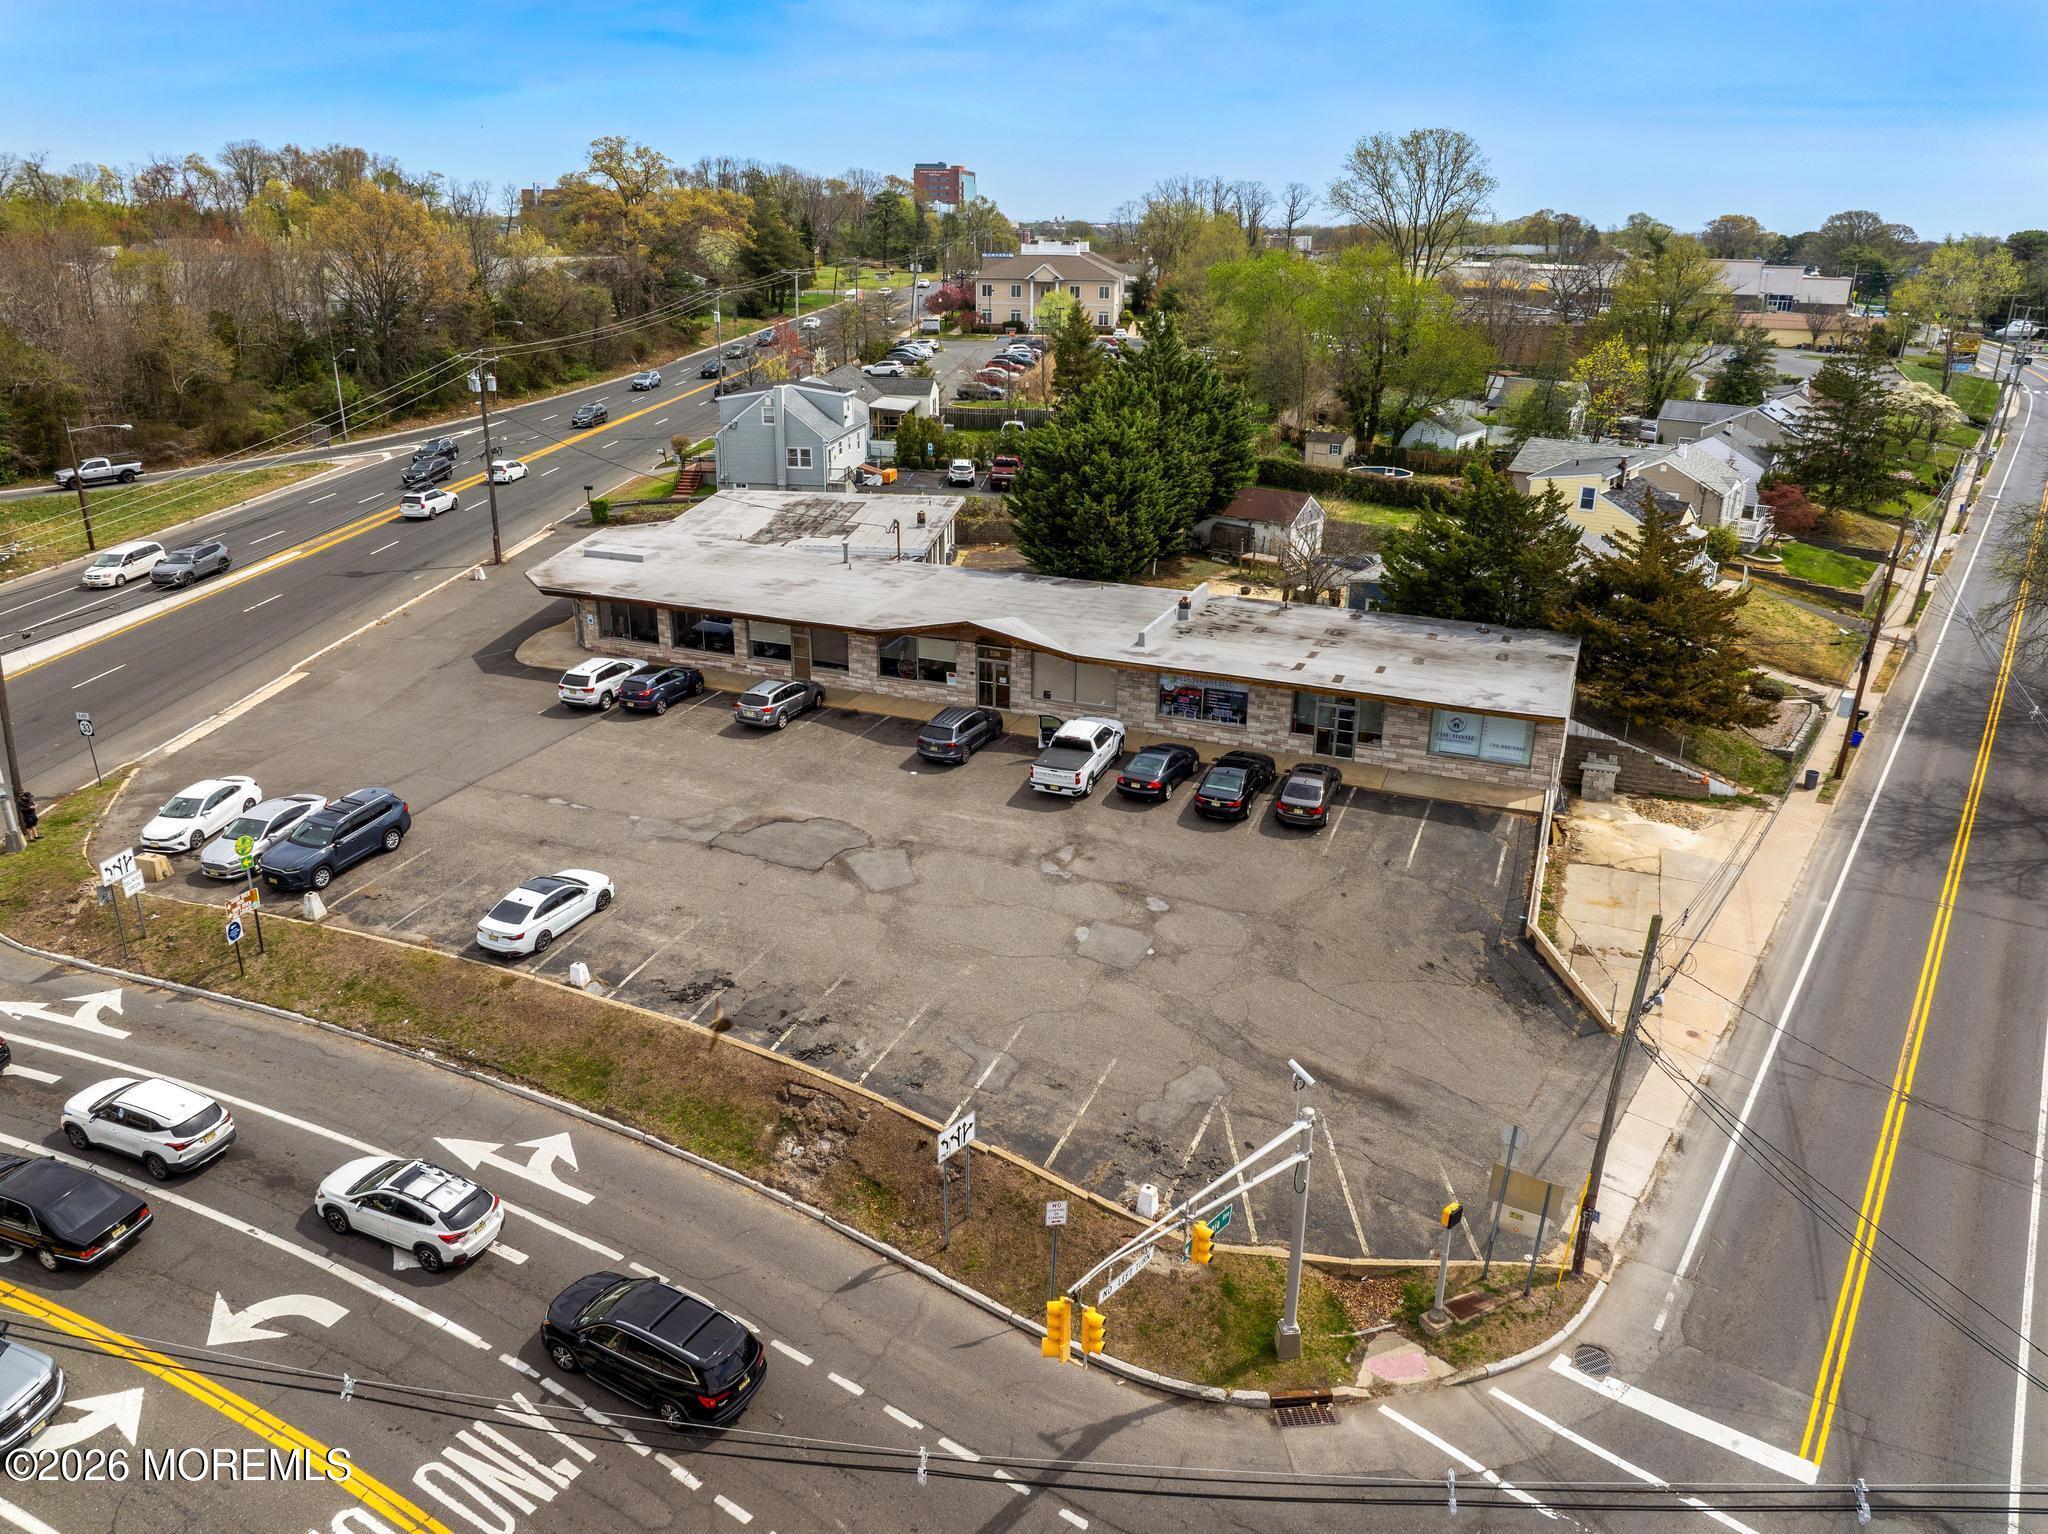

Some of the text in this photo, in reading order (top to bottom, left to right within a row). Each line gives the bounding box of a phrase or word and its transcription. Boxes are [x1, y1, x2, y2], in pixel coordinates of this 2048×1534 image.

[82, 724, 91, 733] 33
[1102, 1253, 1151, 1299] NO LEFT TURN
[413, 1392, 597, 1534] ONLY
